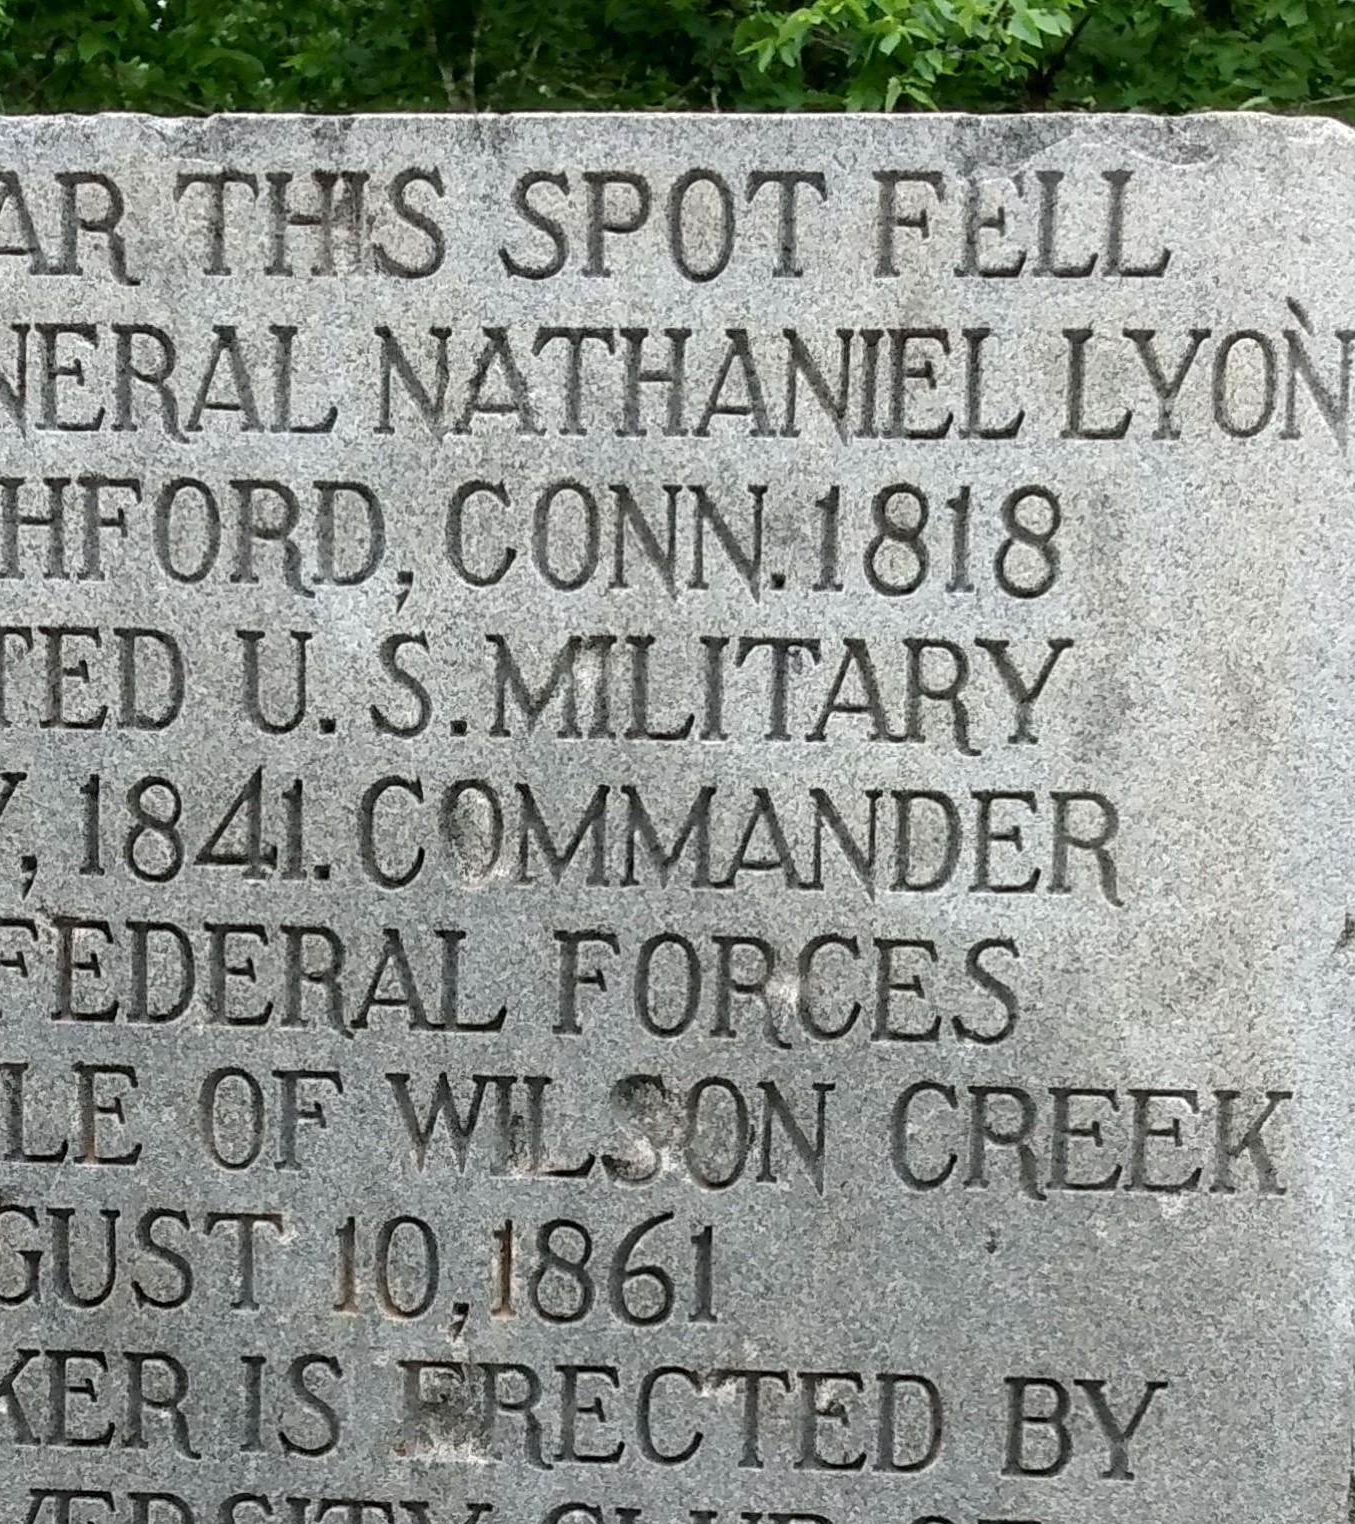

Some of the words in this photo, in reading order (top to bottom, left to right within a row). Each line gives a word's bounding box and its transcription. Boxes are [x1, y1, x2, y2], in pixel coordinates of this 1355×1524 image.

[174, 167, 446, 279] THIS
[499, 167, 827, 282] SPOT
[873, 170, 1172, 278] FELL
[374, 325, 1025, 445] NATHANIEL
[446, 479, 786, 601] CONN.
[812, 482, 1063, 599] 1818
[485, 634, 1075, 756] MILITARY
[79, 766, 331, 883] 1841.
[357, 774, 1125, 906] COMMANDER
[553, 930, 1021, 1049] FORCES
[199, 1066, 344, 1171] OF
[386, 1072, 836, 1196] WILSON
[891, 1080, 1293, 1200] CREEK
[333, 1216, 470, 1341] 10,
[491, 1211, 717, 1326] 1861
[241, 1354, 344, 1457] IS
[396, 1359, 943, 1474] ERECTED
[1000, 1375, 1169, 1480] BY
